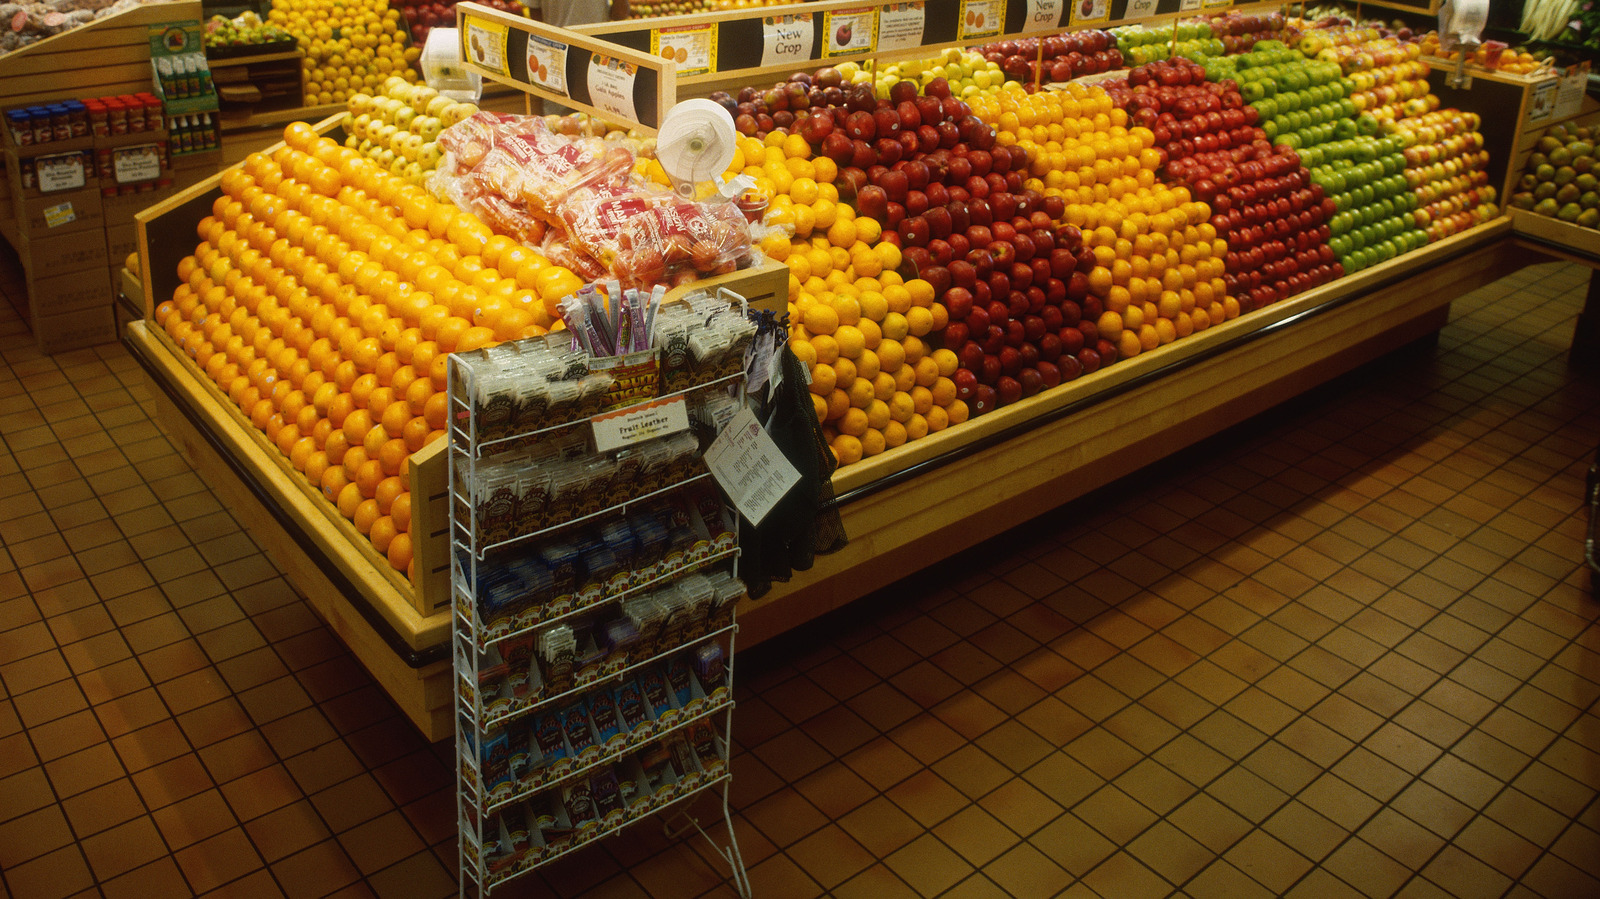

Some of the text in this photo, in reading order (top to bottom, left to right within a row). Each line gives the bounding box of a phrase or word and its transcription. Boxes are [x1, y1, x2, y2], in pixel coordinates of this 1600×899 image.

[1036, 0, 1055, 11] New
[1134, 0, 1151, 11] Crop
[1034, 11, 1054, 23] Crop
[777, 28, 803, 41] New
[710, 23, 718, 73] ORGANIC
[775, 42, 802, 55] Crop
[609, 373, 656, 392] FRUIT
[619, 417, 668, 435] Fruit Leather
